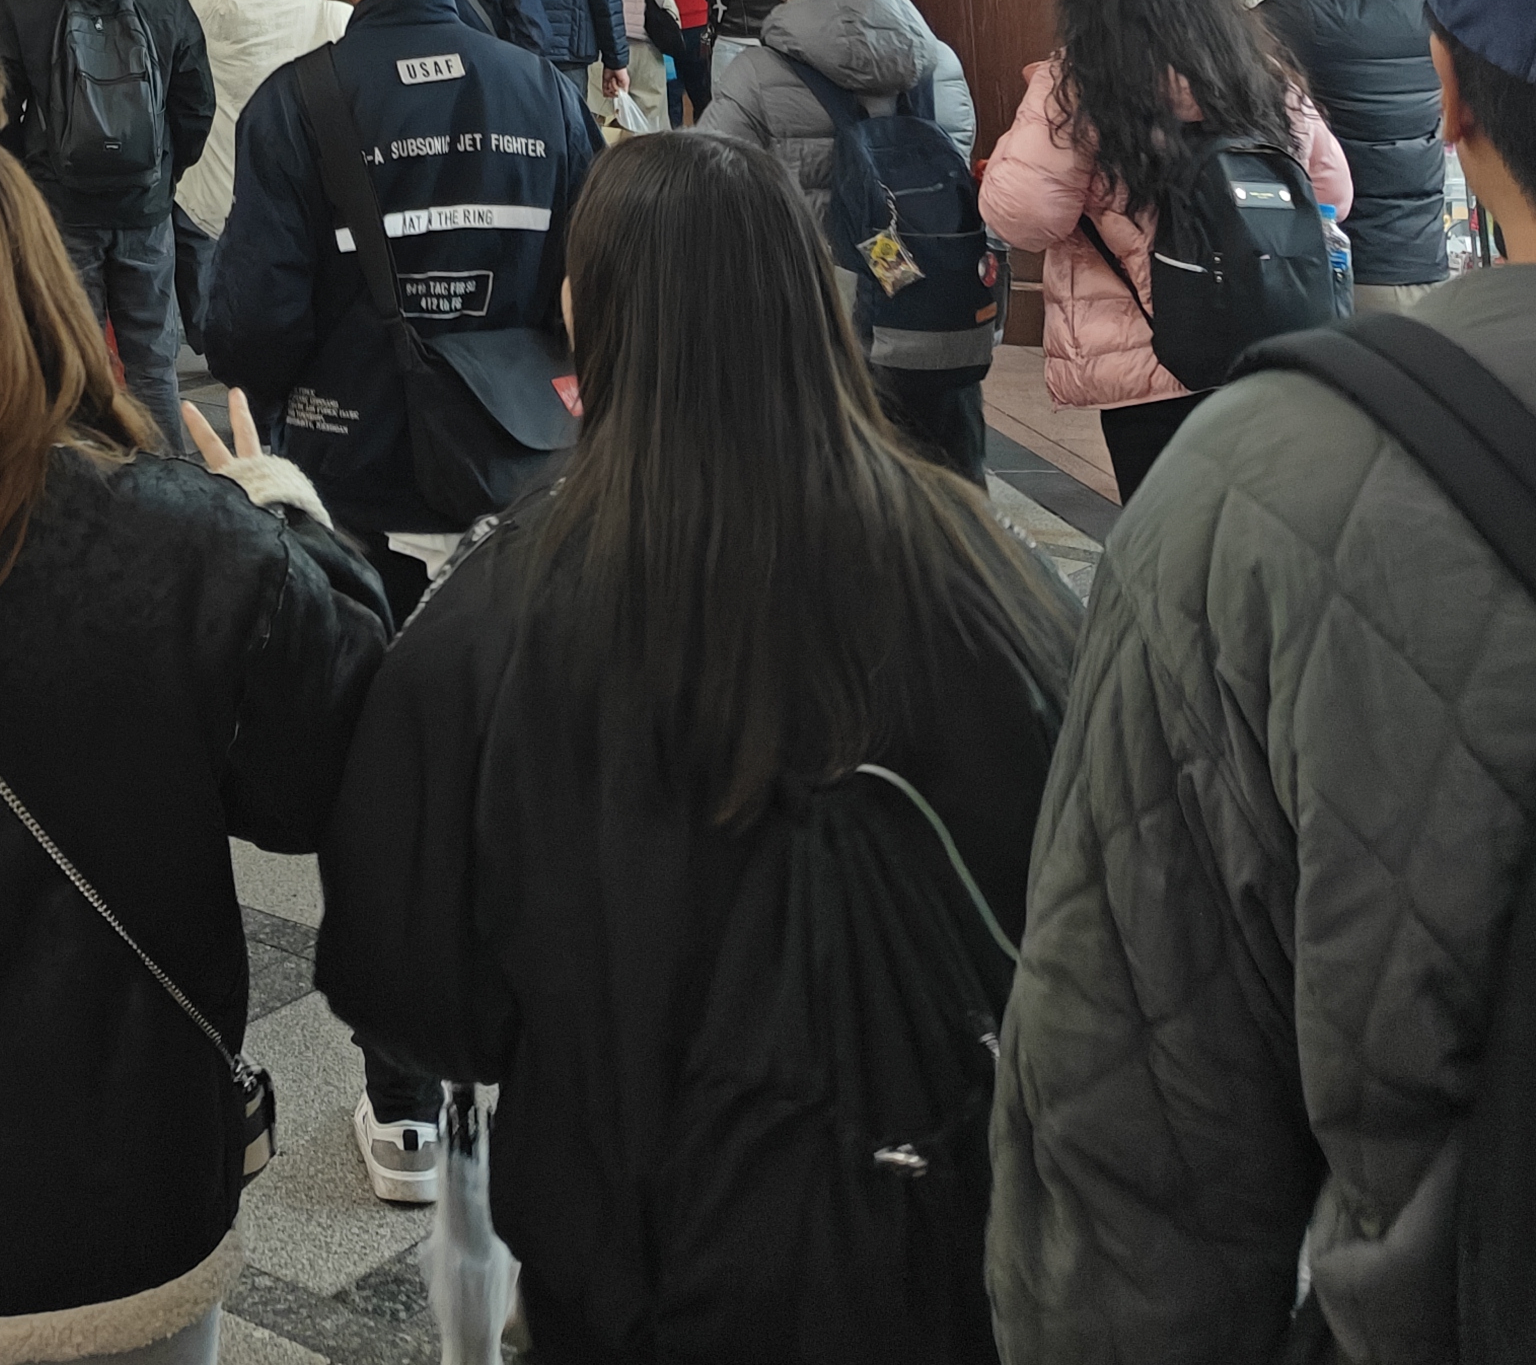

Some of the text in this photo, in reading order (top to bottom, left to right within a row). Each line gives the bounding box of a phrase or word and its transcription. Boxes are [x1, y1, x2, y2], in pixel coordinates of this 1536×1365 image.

[405, 58, 455, 80] USAF
[457, 134, 483, 152] JET
[491, 134, 547, 158] FIGHTER
[437, 210, 459, 226] THE
[463, 208, 493, 226] RING
